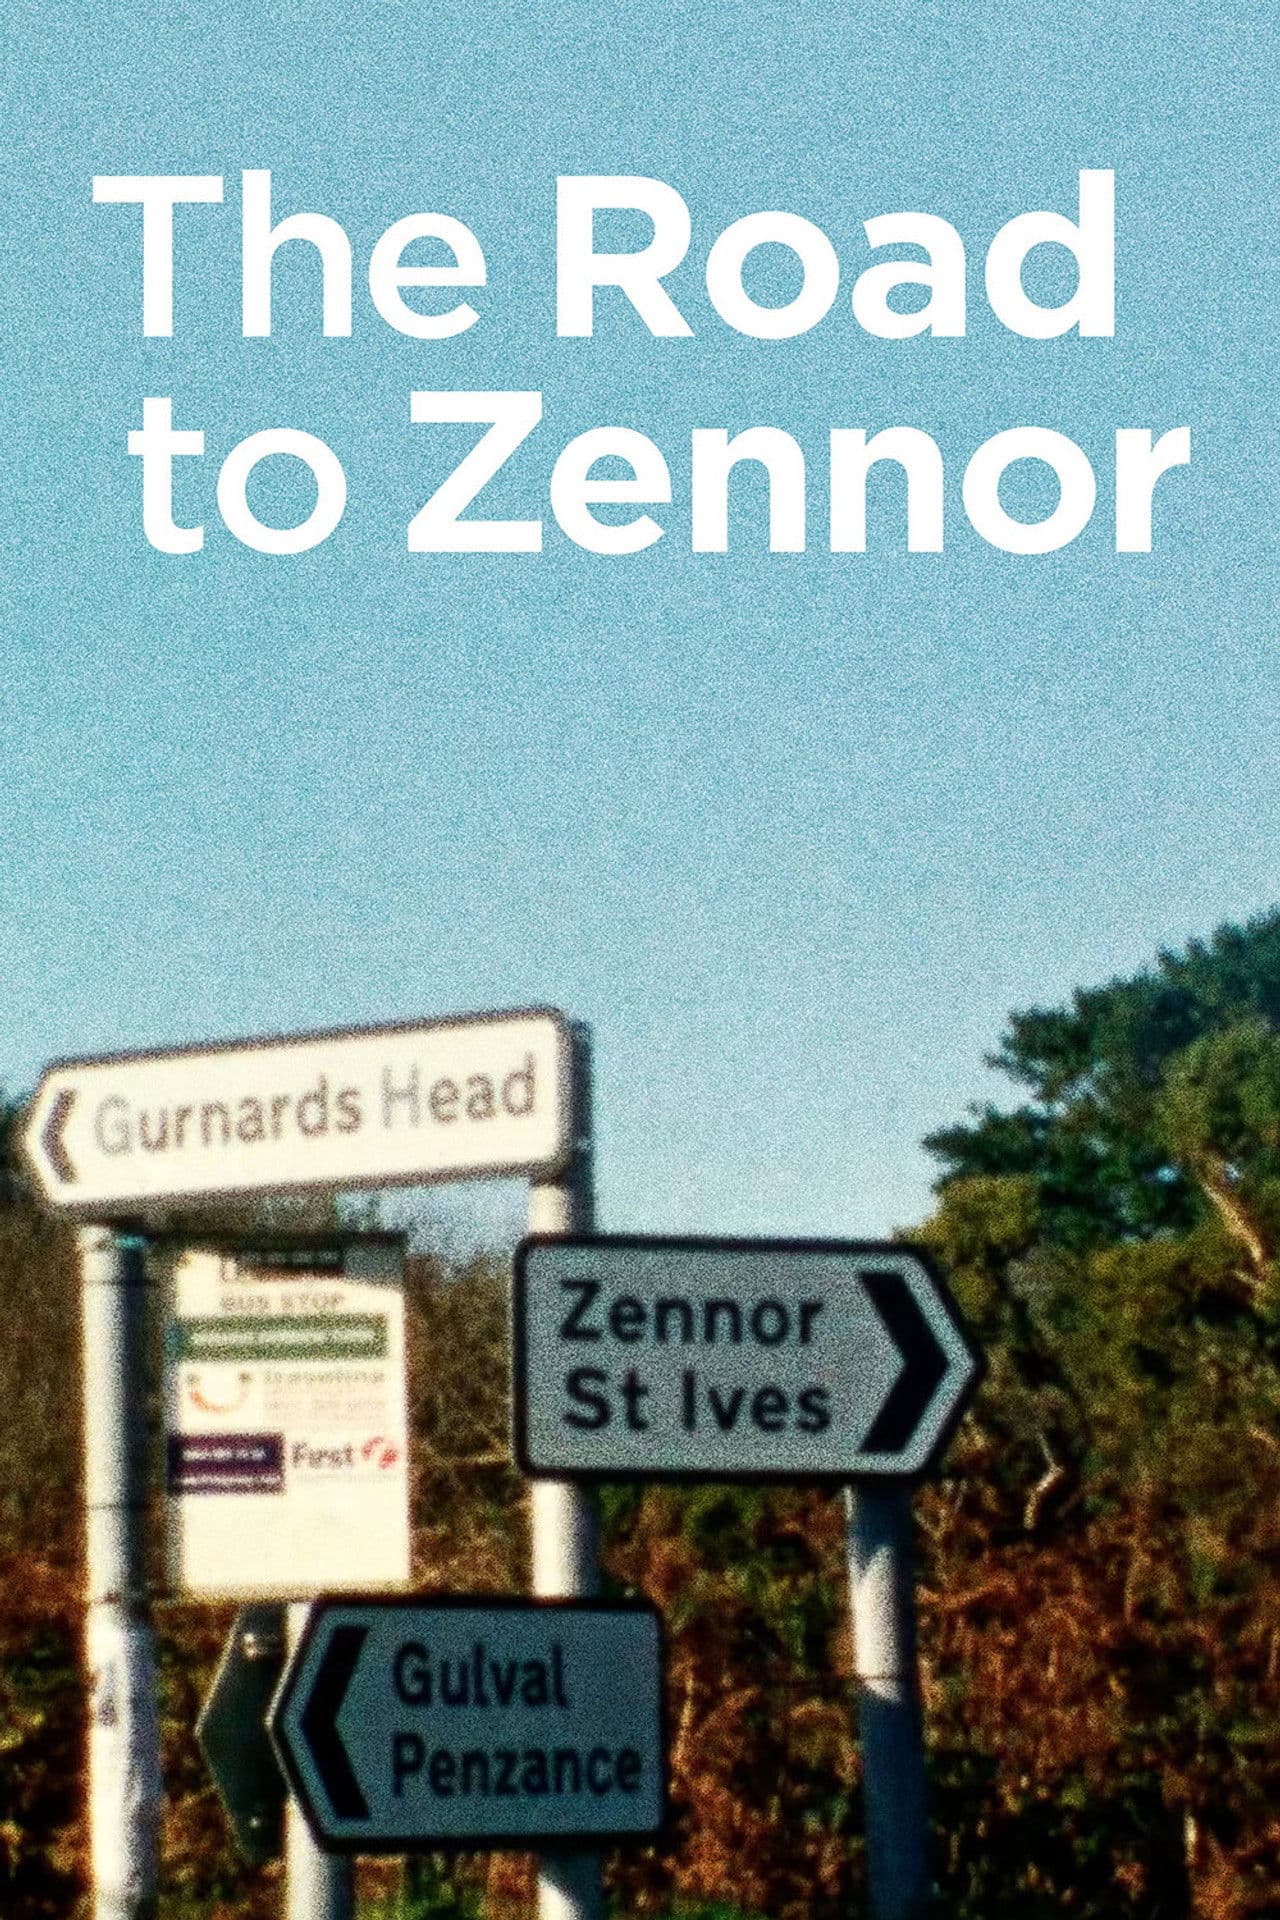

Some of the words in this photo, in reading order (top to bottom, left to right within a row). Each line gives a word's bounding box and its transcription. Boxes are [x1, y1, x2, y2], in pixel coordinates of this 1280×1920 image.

[94, 1073, 362, 1156] Gurnards
[381, 1051, 537, 1129] Head
[560, 1279, 824, 1346] Zennor
[562, 1366, 650, 1431] St
[681, 1368, 831, 1432] Ives
[393, 1641, 568, 1708] Gulval
[393, 1733, 642, 1797] Penzance
